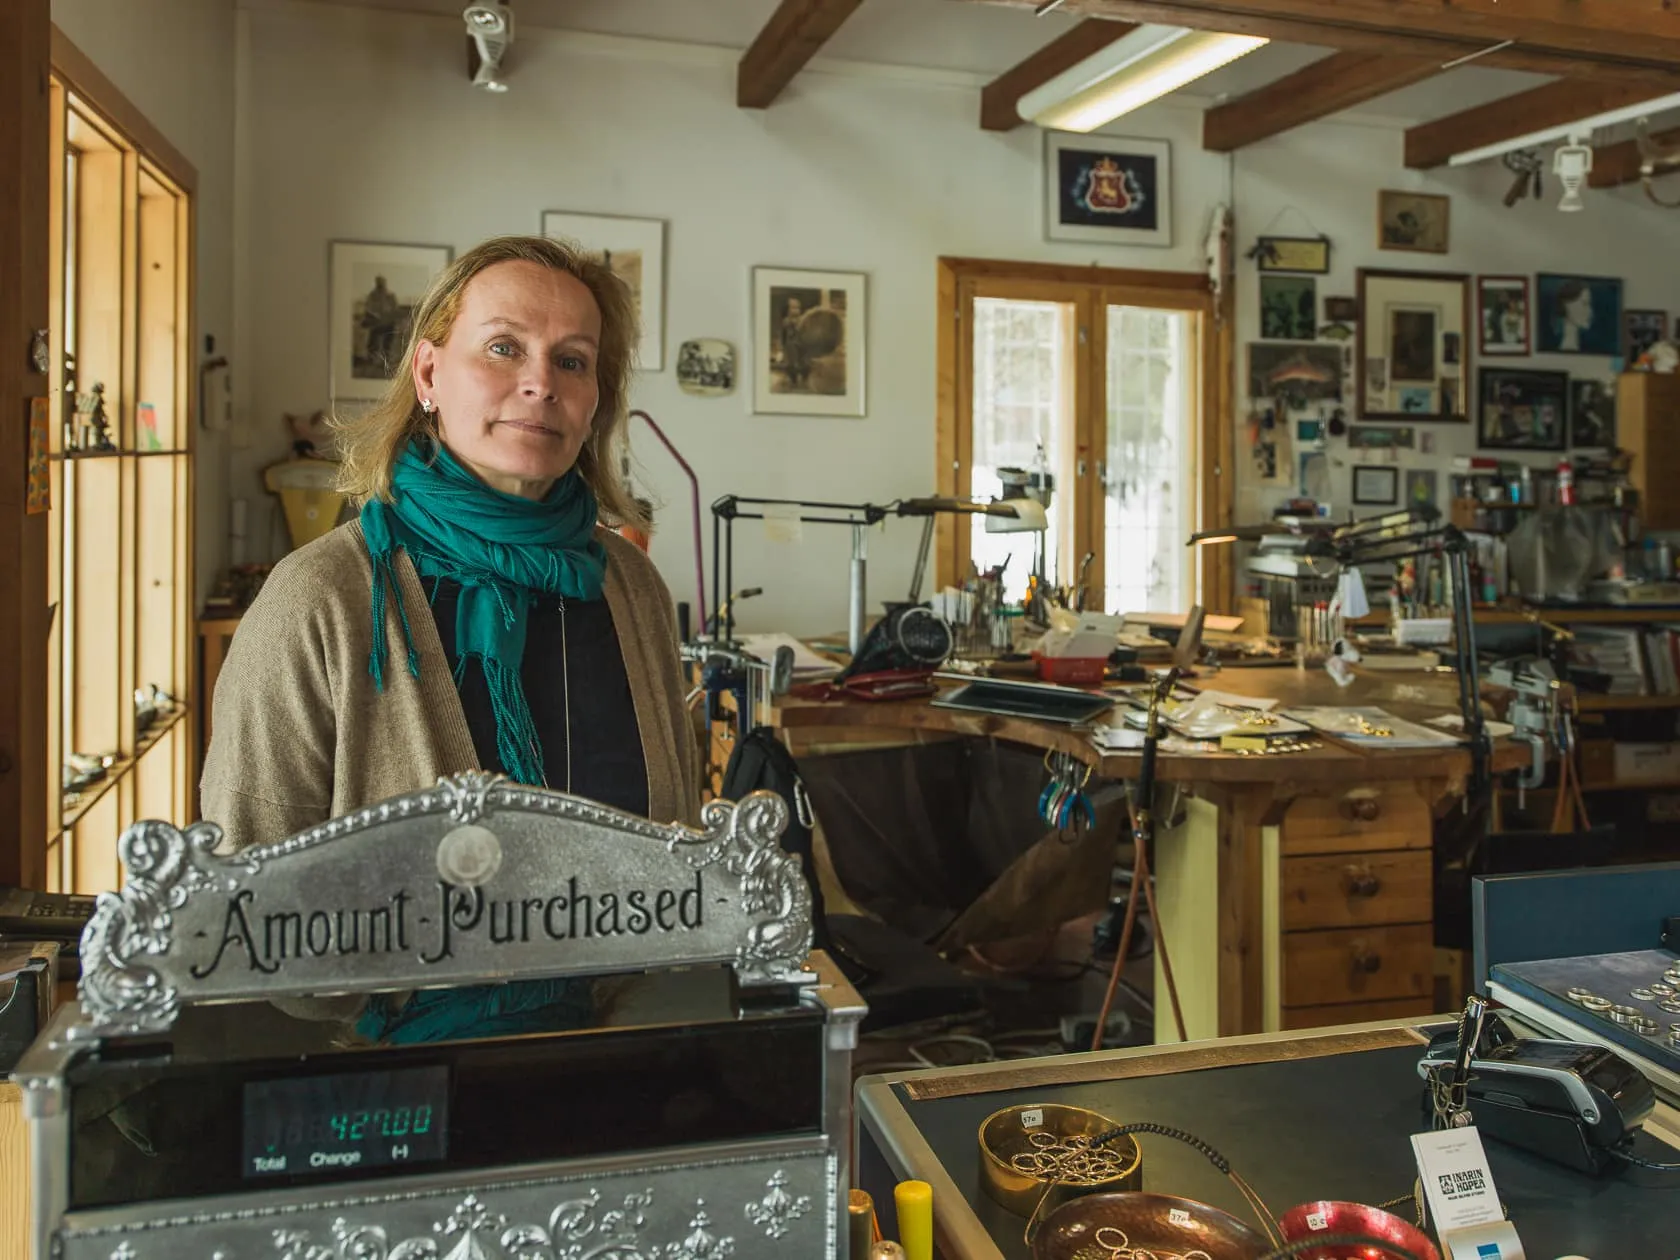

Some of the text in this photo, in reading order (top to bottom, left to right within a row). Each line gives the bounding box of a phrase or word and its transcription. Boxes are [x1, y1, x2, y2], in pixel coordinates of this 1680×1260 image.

[190, 869, 703, 979] Amount Purchased
[253, 1155, 287, 1171] Total
[310, 1151, 361, 1167] Change
[1452, 1168, 1484, 1183] INARIN
[1456, 1178, 1486, 1192] HOPEA
